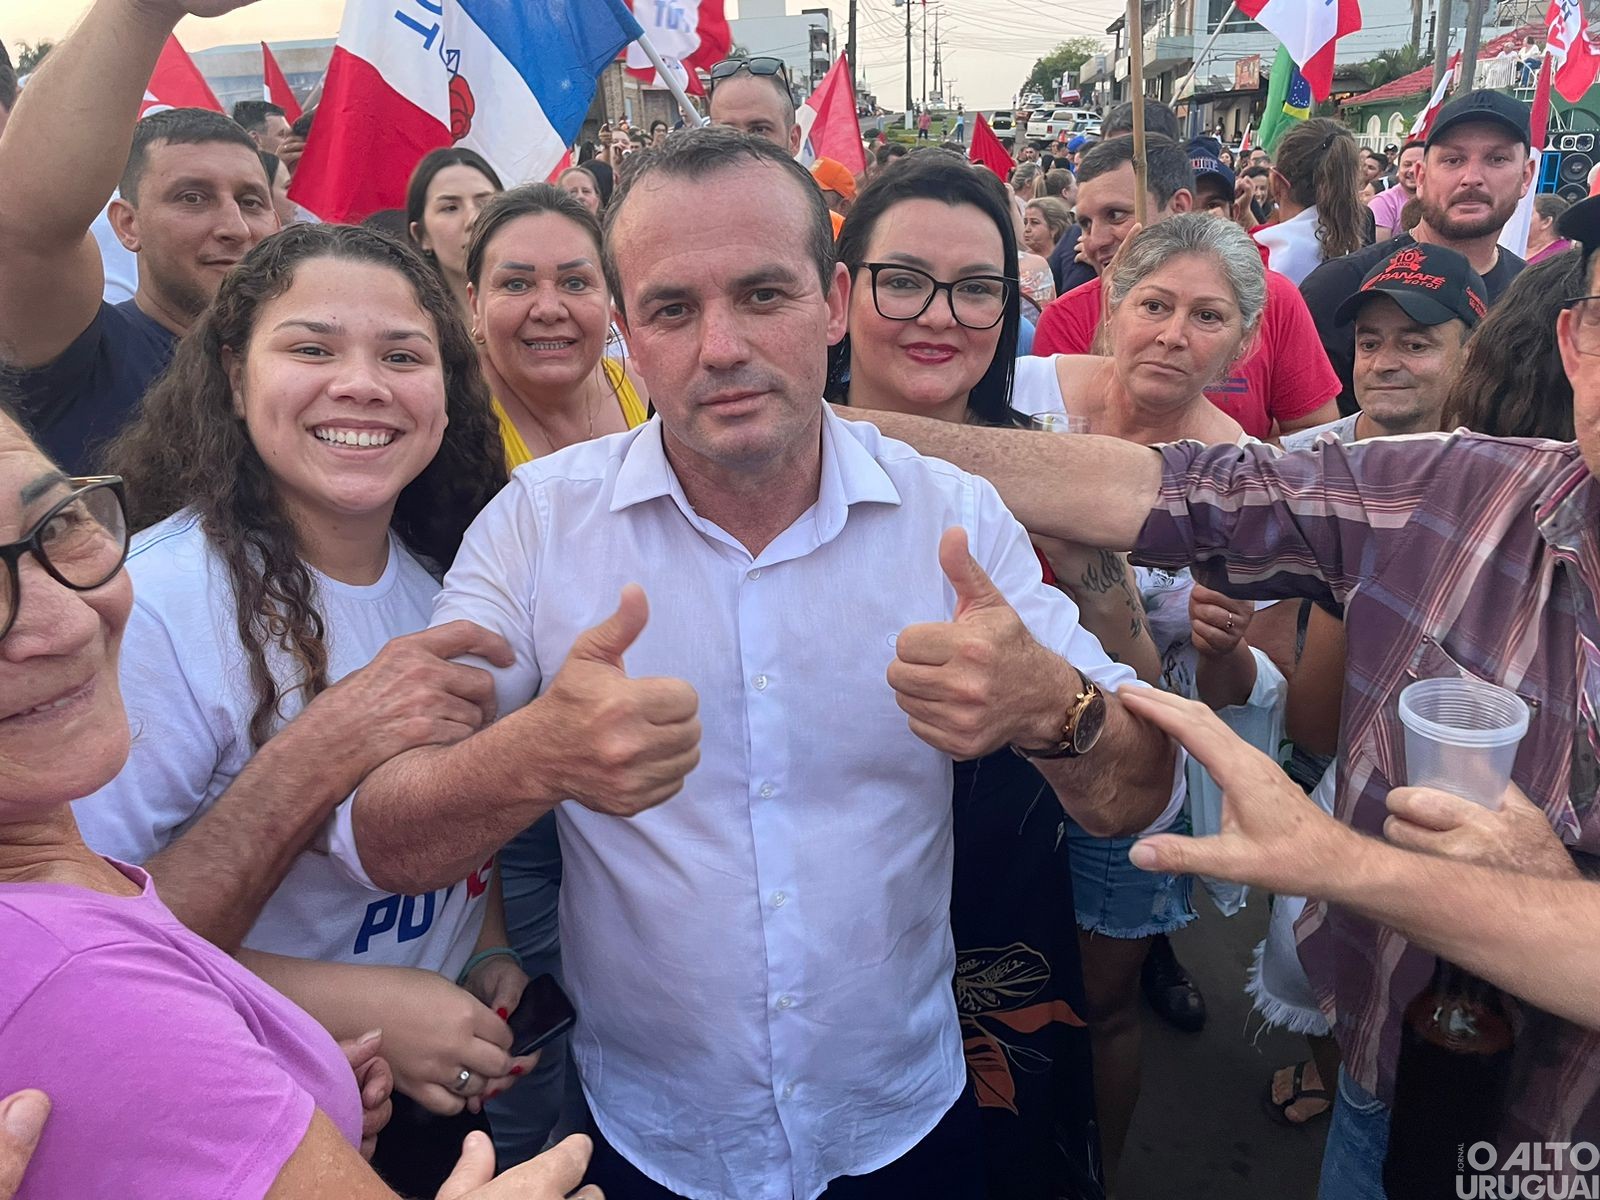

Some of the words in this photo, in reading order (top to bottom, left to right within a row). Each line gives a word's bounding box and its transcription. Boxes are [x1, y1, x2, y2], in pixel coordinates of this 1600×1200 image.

[1399, 252, 1415, 262] 10
[1379, 271, 1446, 286] PANAFÉ
[1403, 279, 1441, 290] MOTOS
[354, 886, 455, 954] PD
